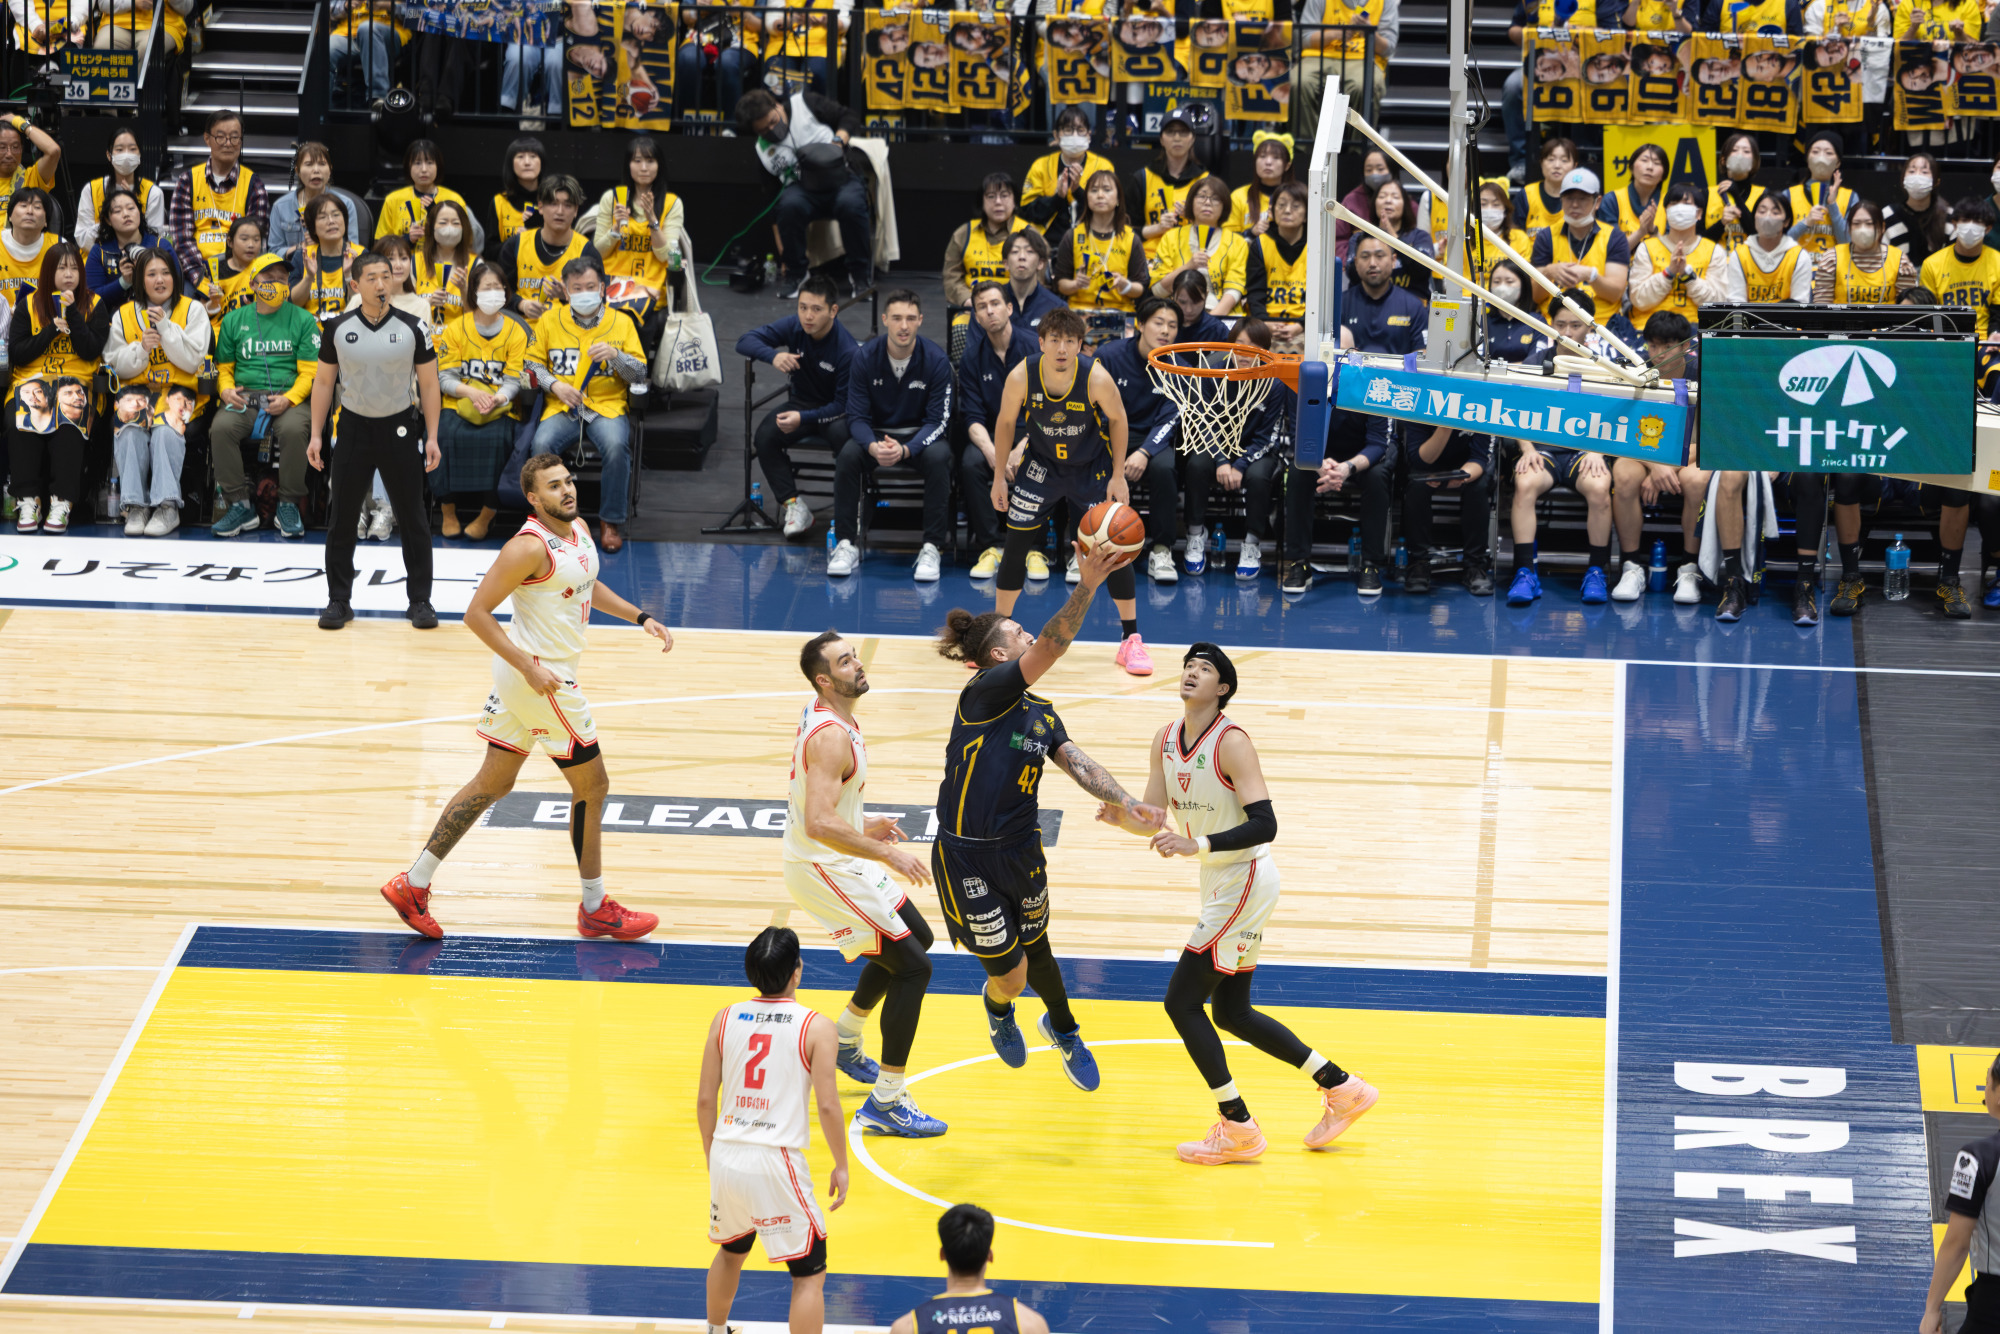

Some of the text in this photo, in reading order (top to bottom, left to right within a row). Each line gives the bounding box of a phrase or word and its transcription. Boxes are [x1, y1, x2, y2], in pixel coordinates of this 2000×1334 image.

[113, 85, 130, 98] 25
[958, 61, 997, 99] 25
[1058, 58, 1097, 96] 25
[1638, 77, 1679, 114] 10
[1698, 84, 1738, 119] 12
[1746, 84, 1788, 122] 18
[255, 341, 293, 352] DIME
[676, 357, 709, 373] BREX
[1785, 377, 1829, 392] SATO
[1424, 388, 1629, 444] MakuIchi
[1056, 444, 1068, 460] 6
[1765, 417, 1908, 466] サトケン
[1822, 454, 1887, 468] since 1977
[1017, 765, 1038, 795] 42
[756, 1012, 793, 1024] 日本電技
[744, 1033, 772, 1090] 2
[736, 1096, 769, 1111] TOGASHI
[1673, 1061, 1858, 1264] BREX
[948, 1310, 1002, 1324] NICIGAS
